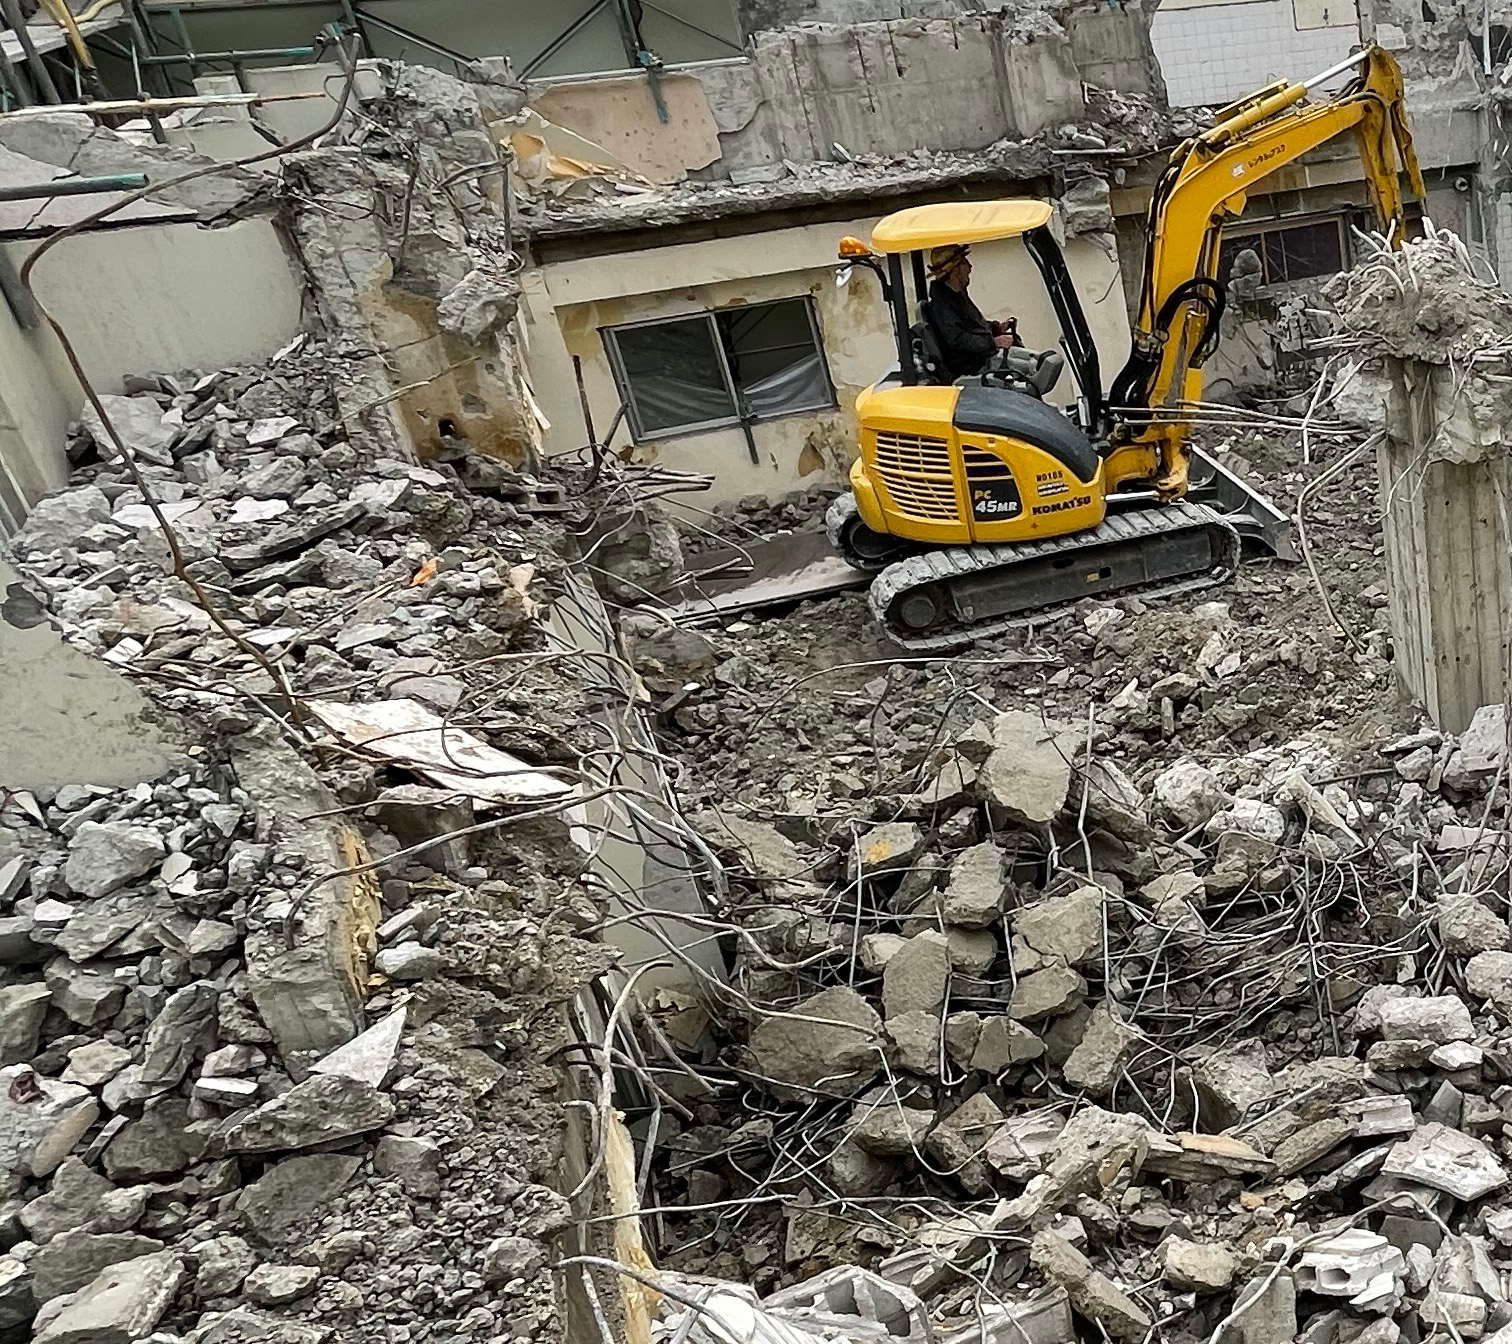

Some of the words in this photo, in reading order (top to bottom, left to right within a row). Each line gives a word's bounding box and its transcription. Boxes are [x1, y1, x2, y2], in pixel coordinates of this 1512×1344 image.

[974, 490, 991, 499] PC
[975, 500, 1018, 513] 45MR
[1032, 496, 1091, 515] KOMATSU
